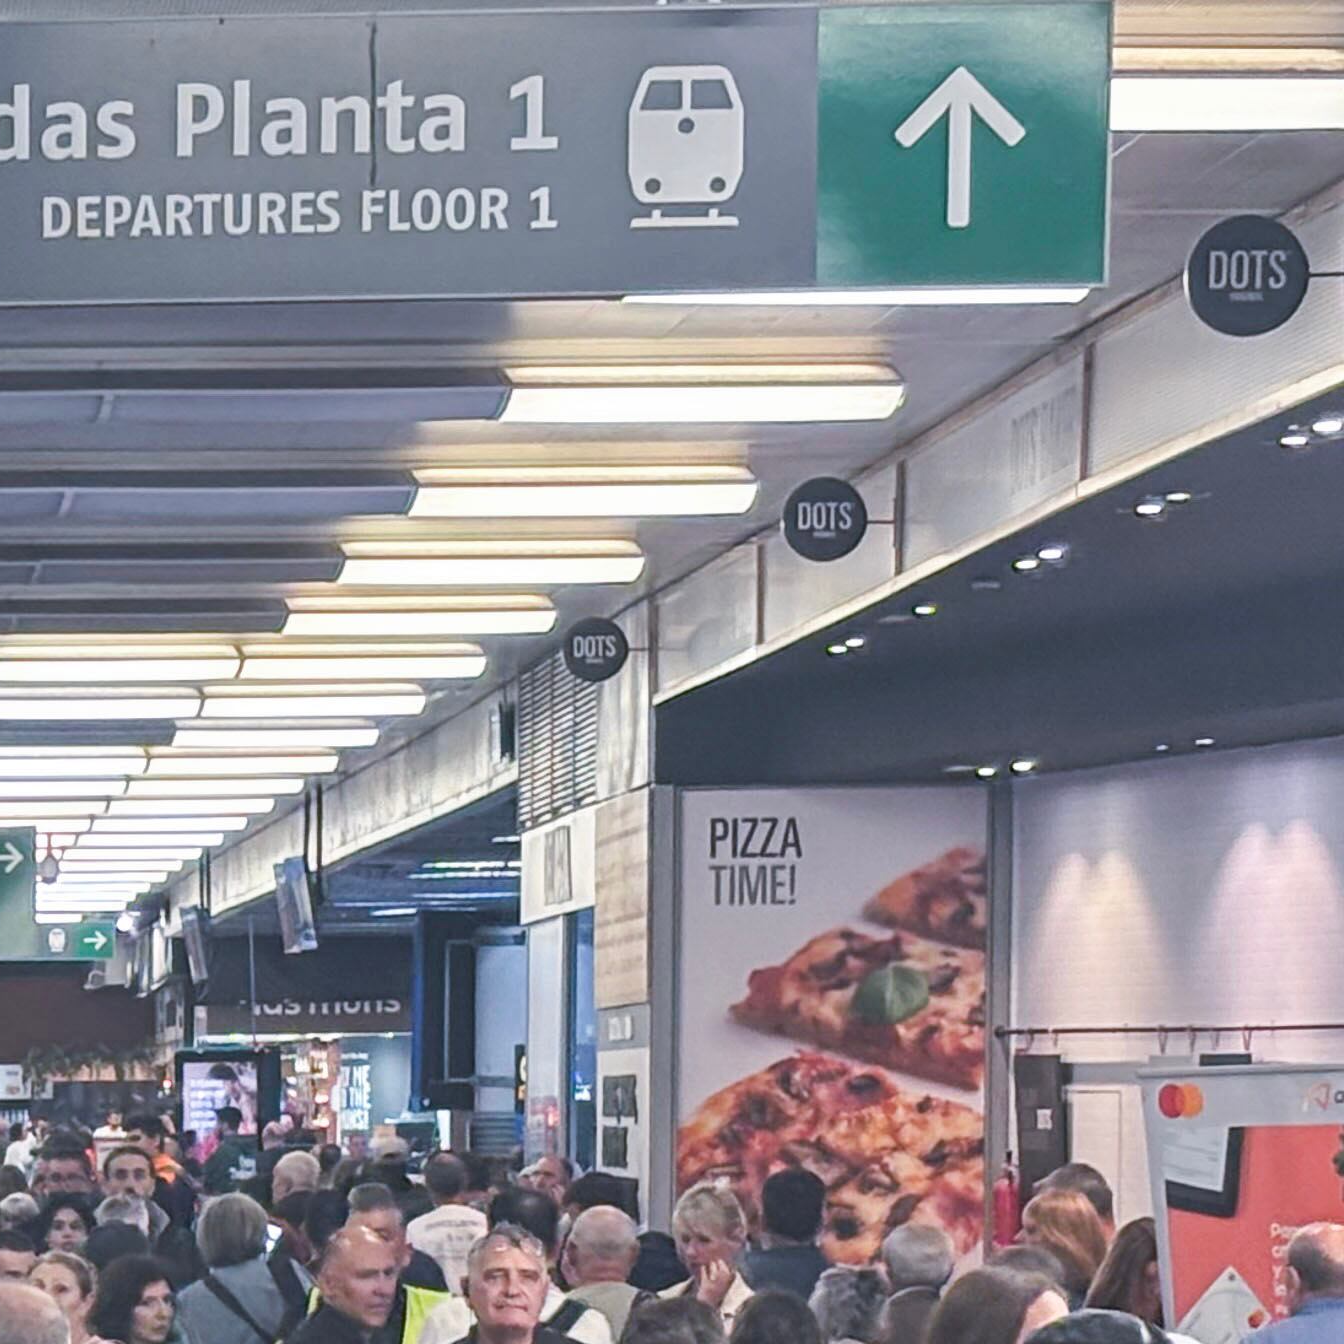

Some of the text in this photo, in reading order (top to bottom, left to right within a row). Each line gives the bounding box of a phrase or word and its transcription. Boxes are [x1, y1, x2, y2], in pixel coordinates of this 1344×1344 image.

[177, 79, 466, 157] Planta
[509, 75, 559, 151] 1
[43, 187, 558, 239] DEPARTURES FLOOR 1
[1209, 250, 1286, 290] DOTS
[798, 502, 852, 530] DOTS
[574, 635, 616, 657] DOTS
[709, 817, 803, 859] PIZZA
[709, 864, 796, 906] TIME!
